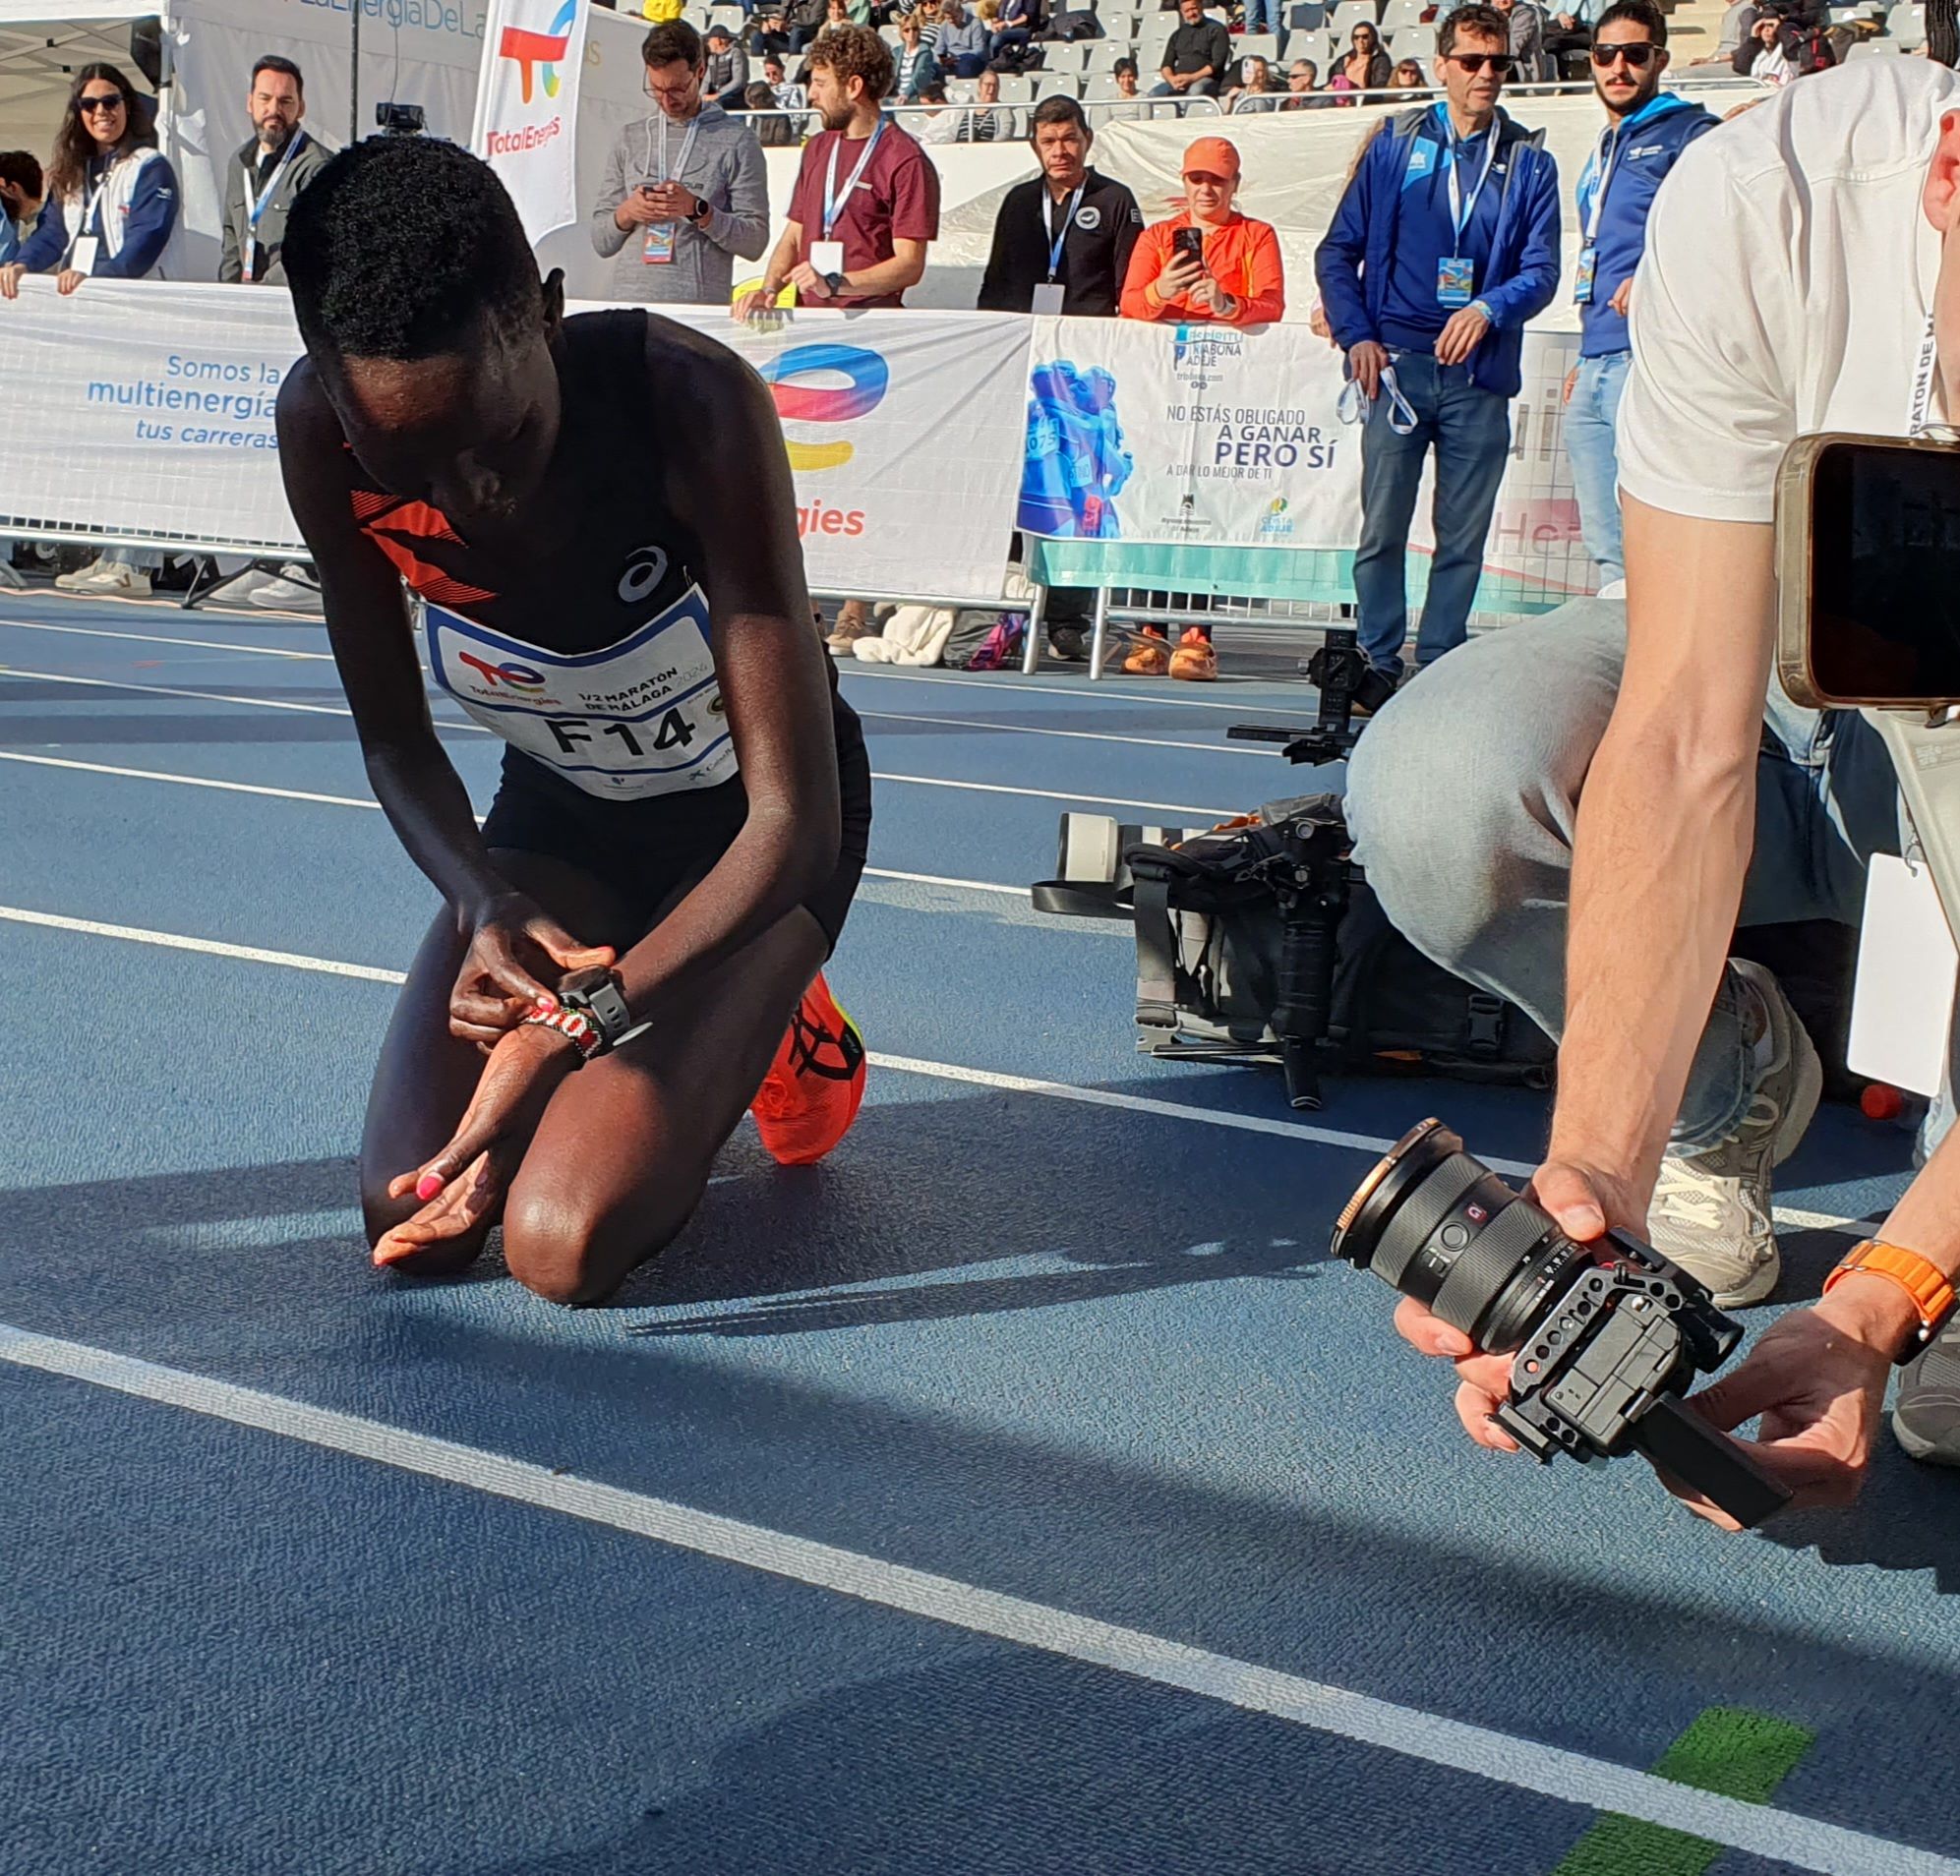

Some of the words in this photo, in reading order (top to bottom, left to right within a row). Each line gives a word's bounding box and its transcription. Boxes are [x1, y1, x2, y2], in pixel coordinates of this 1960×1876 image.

[167, 355, 252, 382] Somos
[260, 362, 281, 384] la
[89, 381, 277, 420] multienergía
[1166, 405, 1186, 422] NO
[1190, 404, 1231, 424] ESTÁS
[1235, 408, 1305, 425] OBLIGADO
[136, 420, 173, 440] tus
[181, 427, 279, 448] carreras
[1218, 424, 1232, 440] A
[1240, 426, 1321, 443] GANAR
[1215, 442, 1297, 467] PERO
[1307, 440, 1338, 469] SÍ
[1166, 464, 1174, 476] A
[1176, 465, 1196, 477] DAR
[1198, 466, 1210, 478] LO
[1213, 466, 1244, 479] MEJOR
[1248, 467, 1260, 479] DE
[1264, 468, 1272, 479] TI
[578, 692, 604, 703] 1/2
[605, 667, 679, 703] MARATÓN
[585, 702, 607, 711] DE
[544, 707, 696, 756] F14
